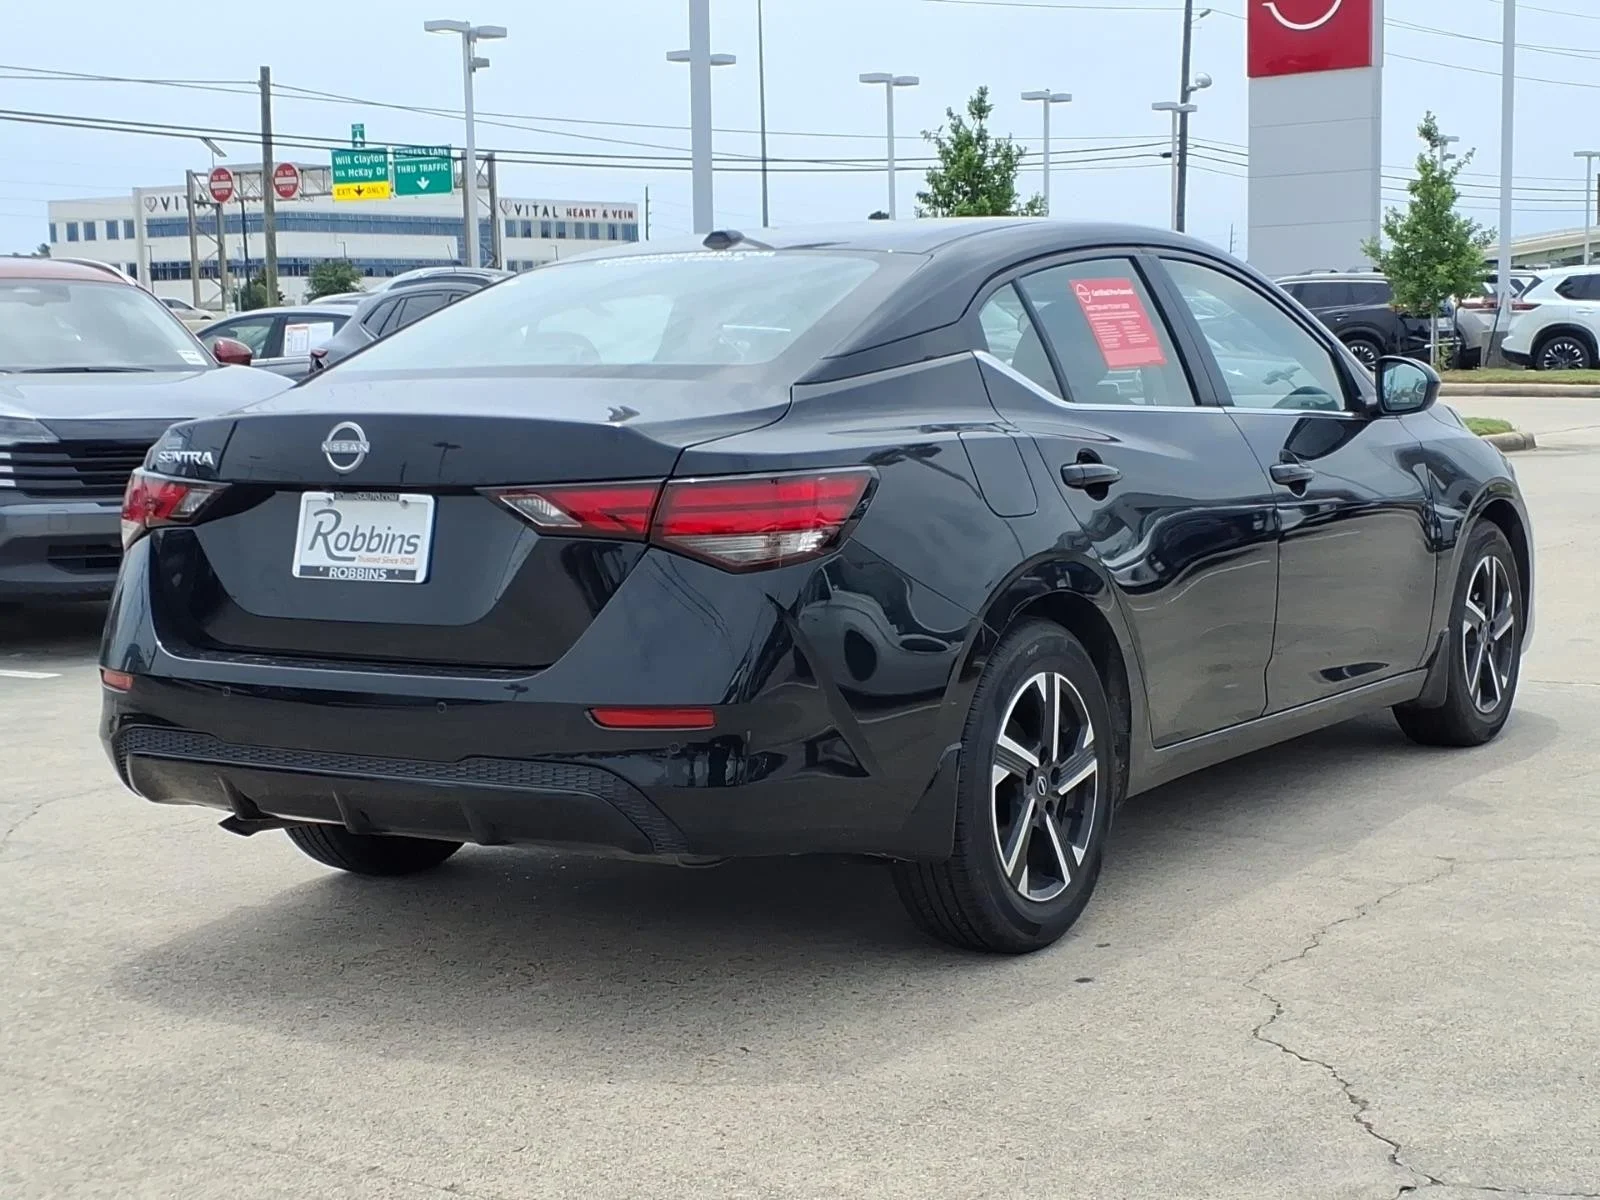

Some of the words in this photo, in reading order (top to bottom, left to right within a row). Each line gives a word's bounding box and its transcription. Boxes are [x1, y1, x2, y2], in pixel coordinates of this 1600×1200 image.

[335, 155, 351, 165] Will
[354, 153, 385, 166] Clayton
[285, 168, 295, 176] NOT
[348, 168, 373, 179] McKay
[376, 167, 386, 176] Dr
[397, 165, 416, 174] THRU
[419, 163, 449, 173] TRAFFIC
[336, 188, 351, 196] EXIT
[366, 187, 385, 195] ONLY
[514, 203, 559, 218] VITAL
[566, 208, 597, 218] HEART
[602, 209, 608, 219] &
[612, 210, 634, 219] VEIN
[321, 441, 370, 454] NISSAN
[157, 450, 214, 466] SENTRA
[308, 508, 421, 562] Robbins
[358, 555, 381, 565] Trusted
[382, 556, 399, 565] Since
[329, 567, 388, 580] ROBBINS
